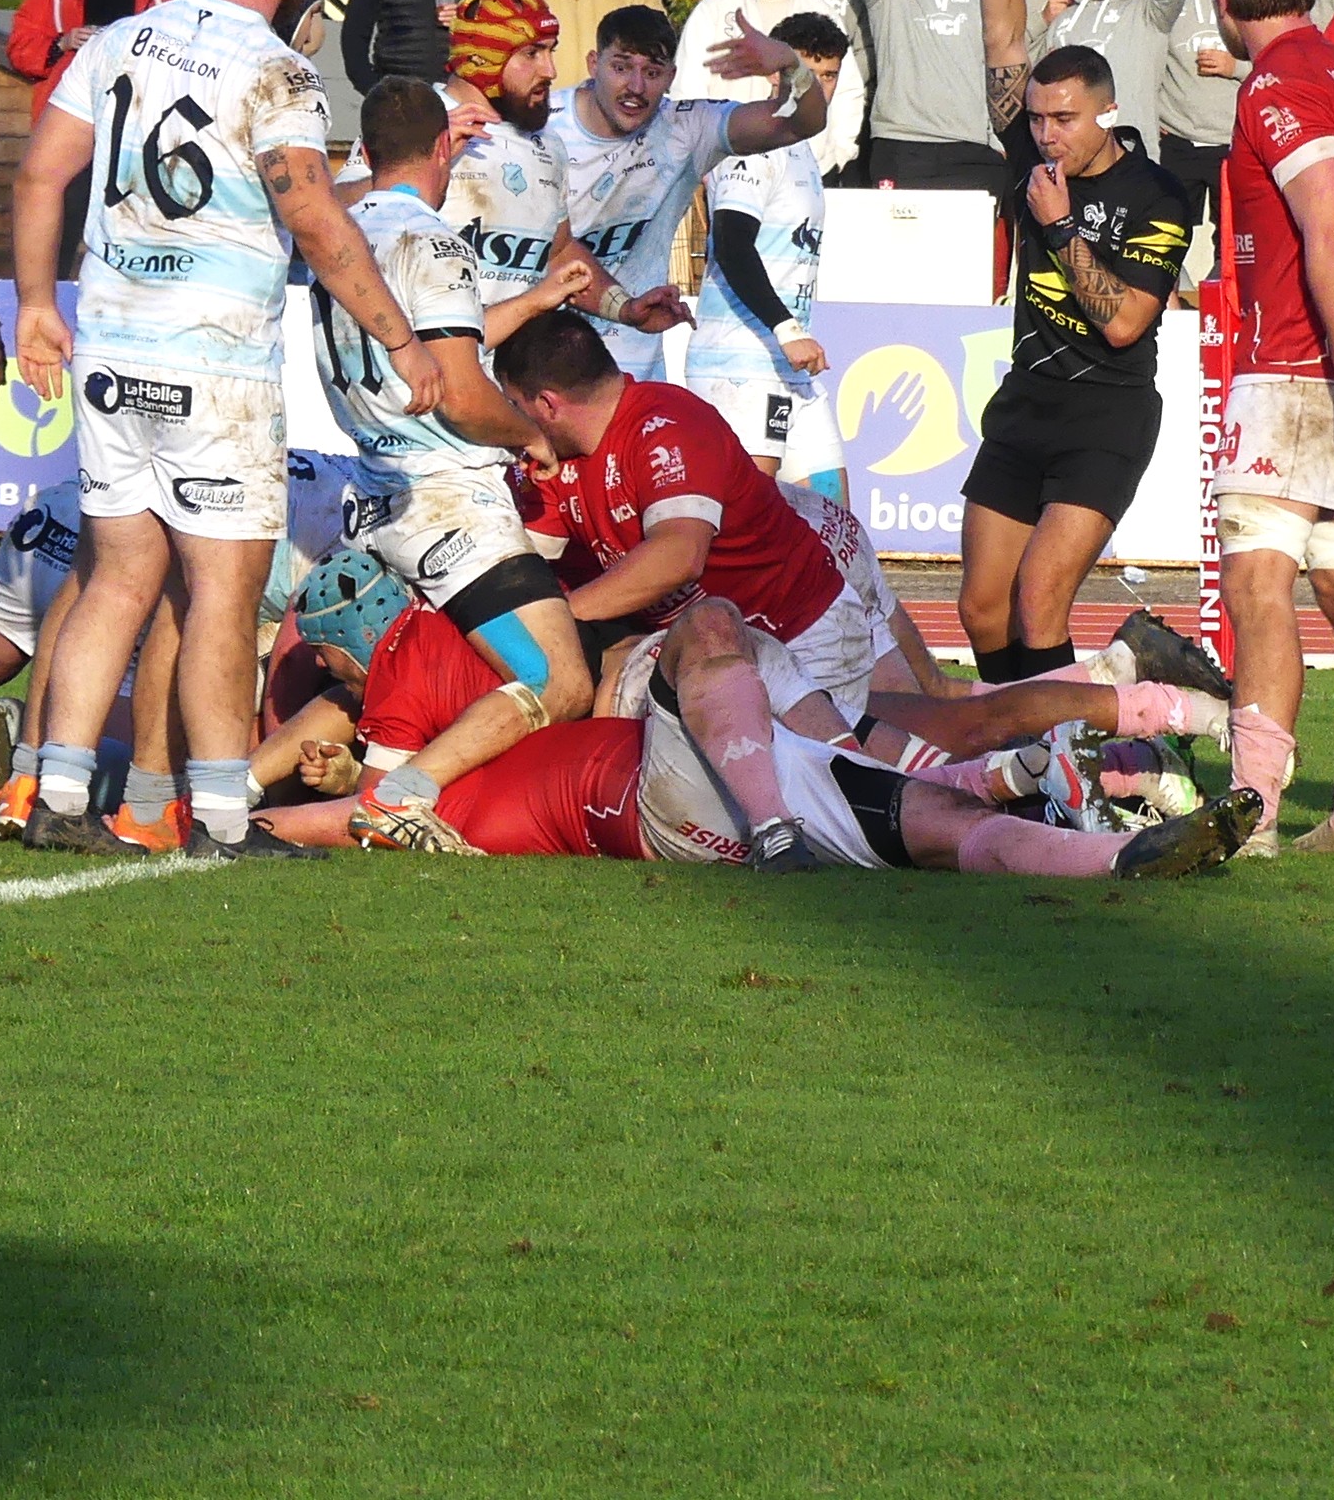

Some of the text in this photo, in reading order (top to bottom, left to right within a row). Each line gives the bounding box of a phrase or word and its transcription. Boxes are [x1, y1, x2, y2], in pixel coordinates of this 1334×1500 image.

[104, 73, 214, 220] 16
[102, 242, 194, 274] Vienne
[1122, 248, 1180, 278] LA POSTE
[136, 397, 183, 416] Sommeil
[1200, 371, 1222, 632] INTERSPORT
